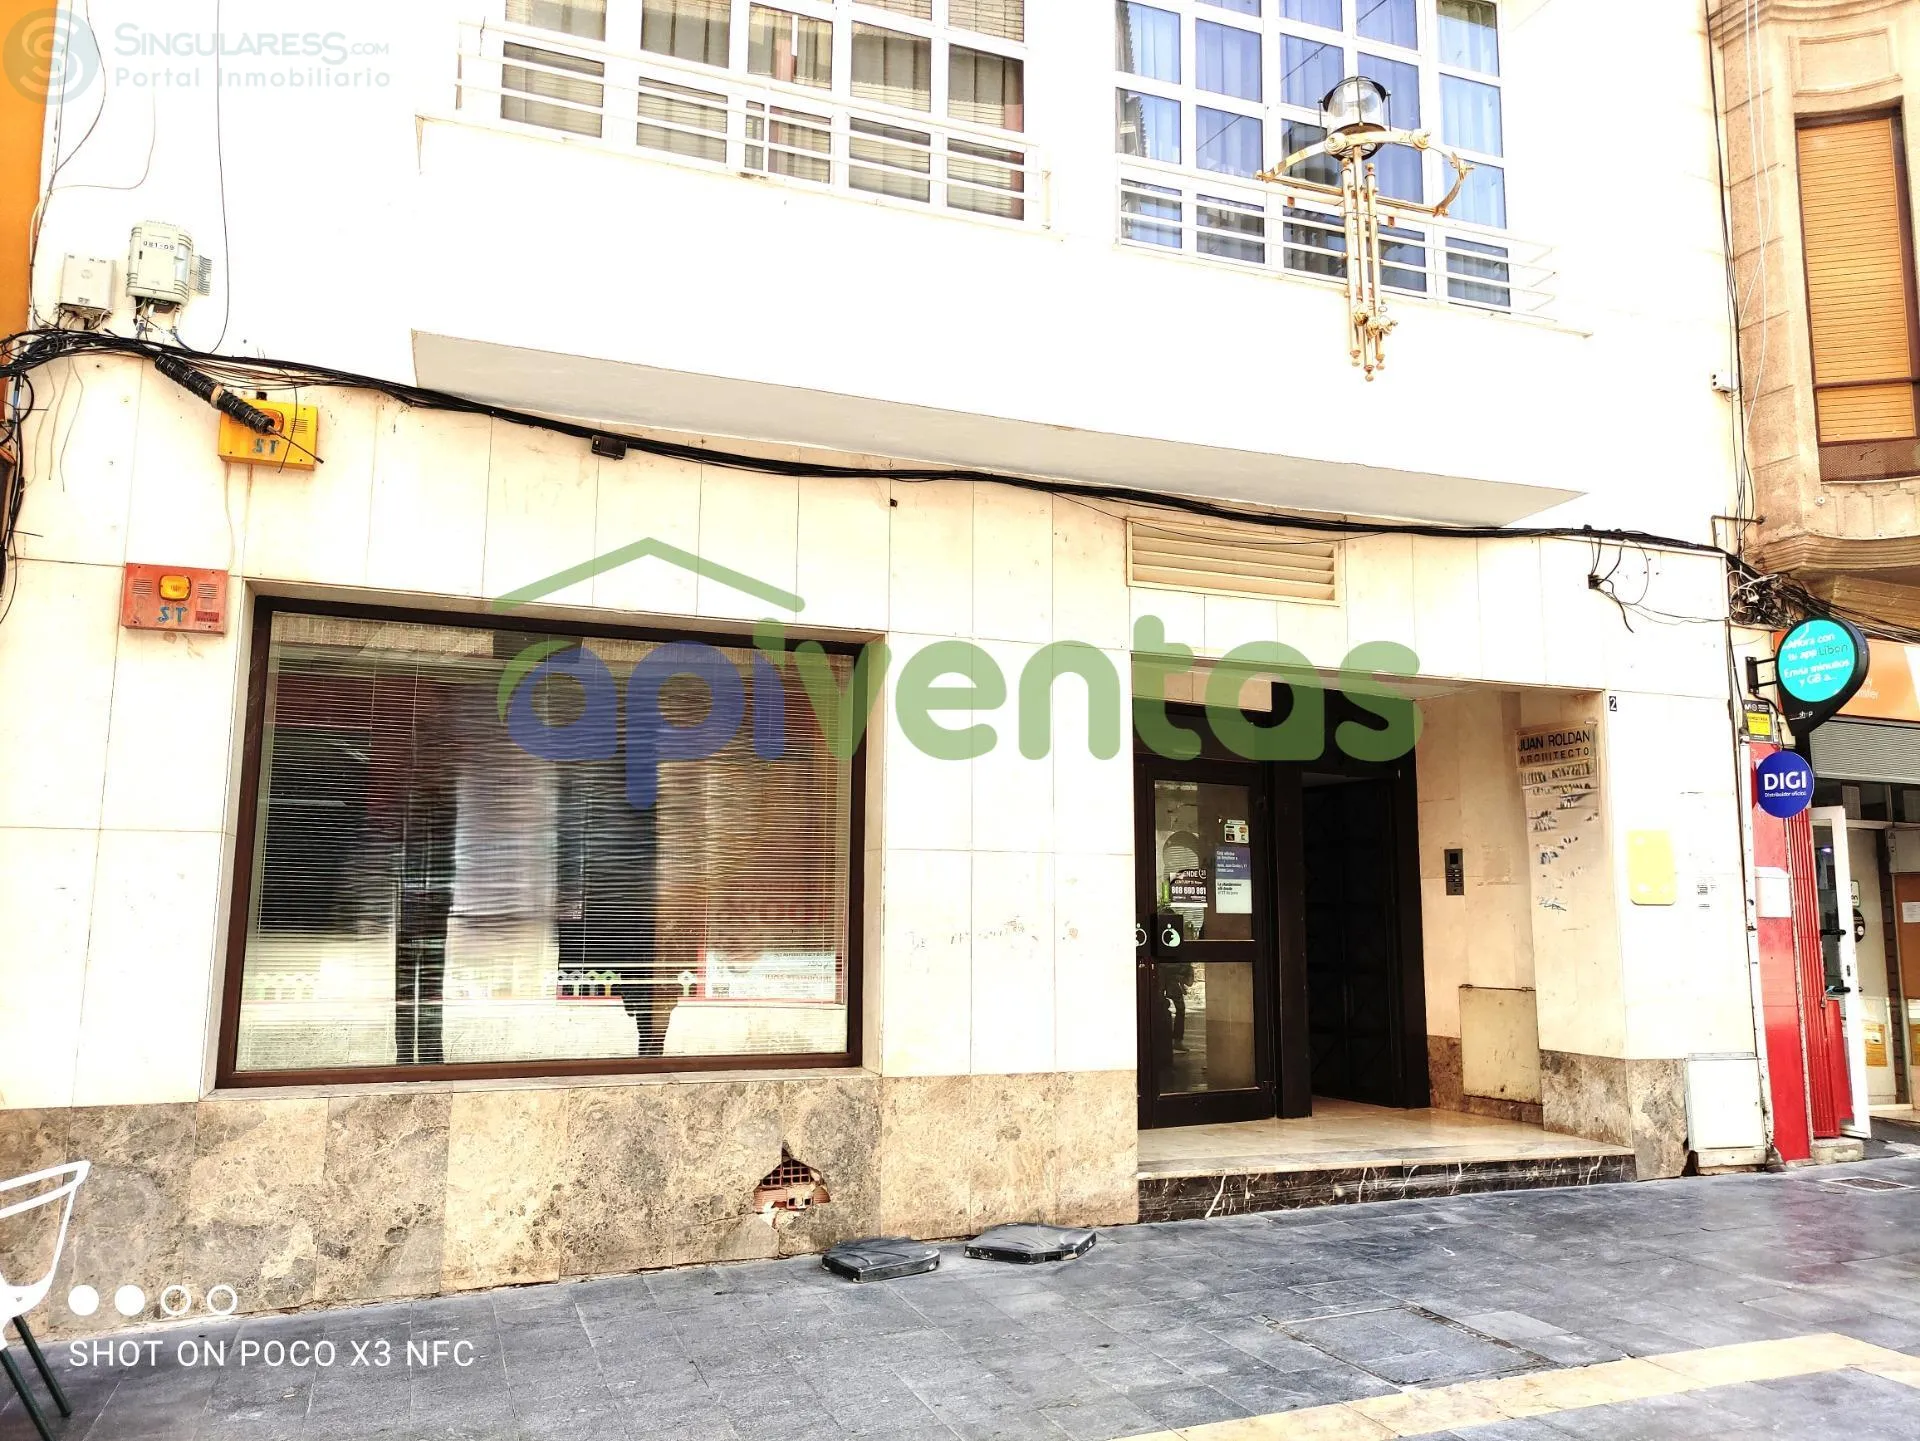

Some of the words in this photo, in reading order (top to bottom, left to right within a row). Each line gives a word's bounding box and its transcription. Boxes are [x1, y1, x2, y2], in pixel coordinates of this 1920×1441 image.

[1609, 696, 1617, 711] 2
[1518, 736, 1543, 752] JUAN
[1548, 730, 1590, 747] ROLDAN
[1764, 770, 1807, 791] DIGI
